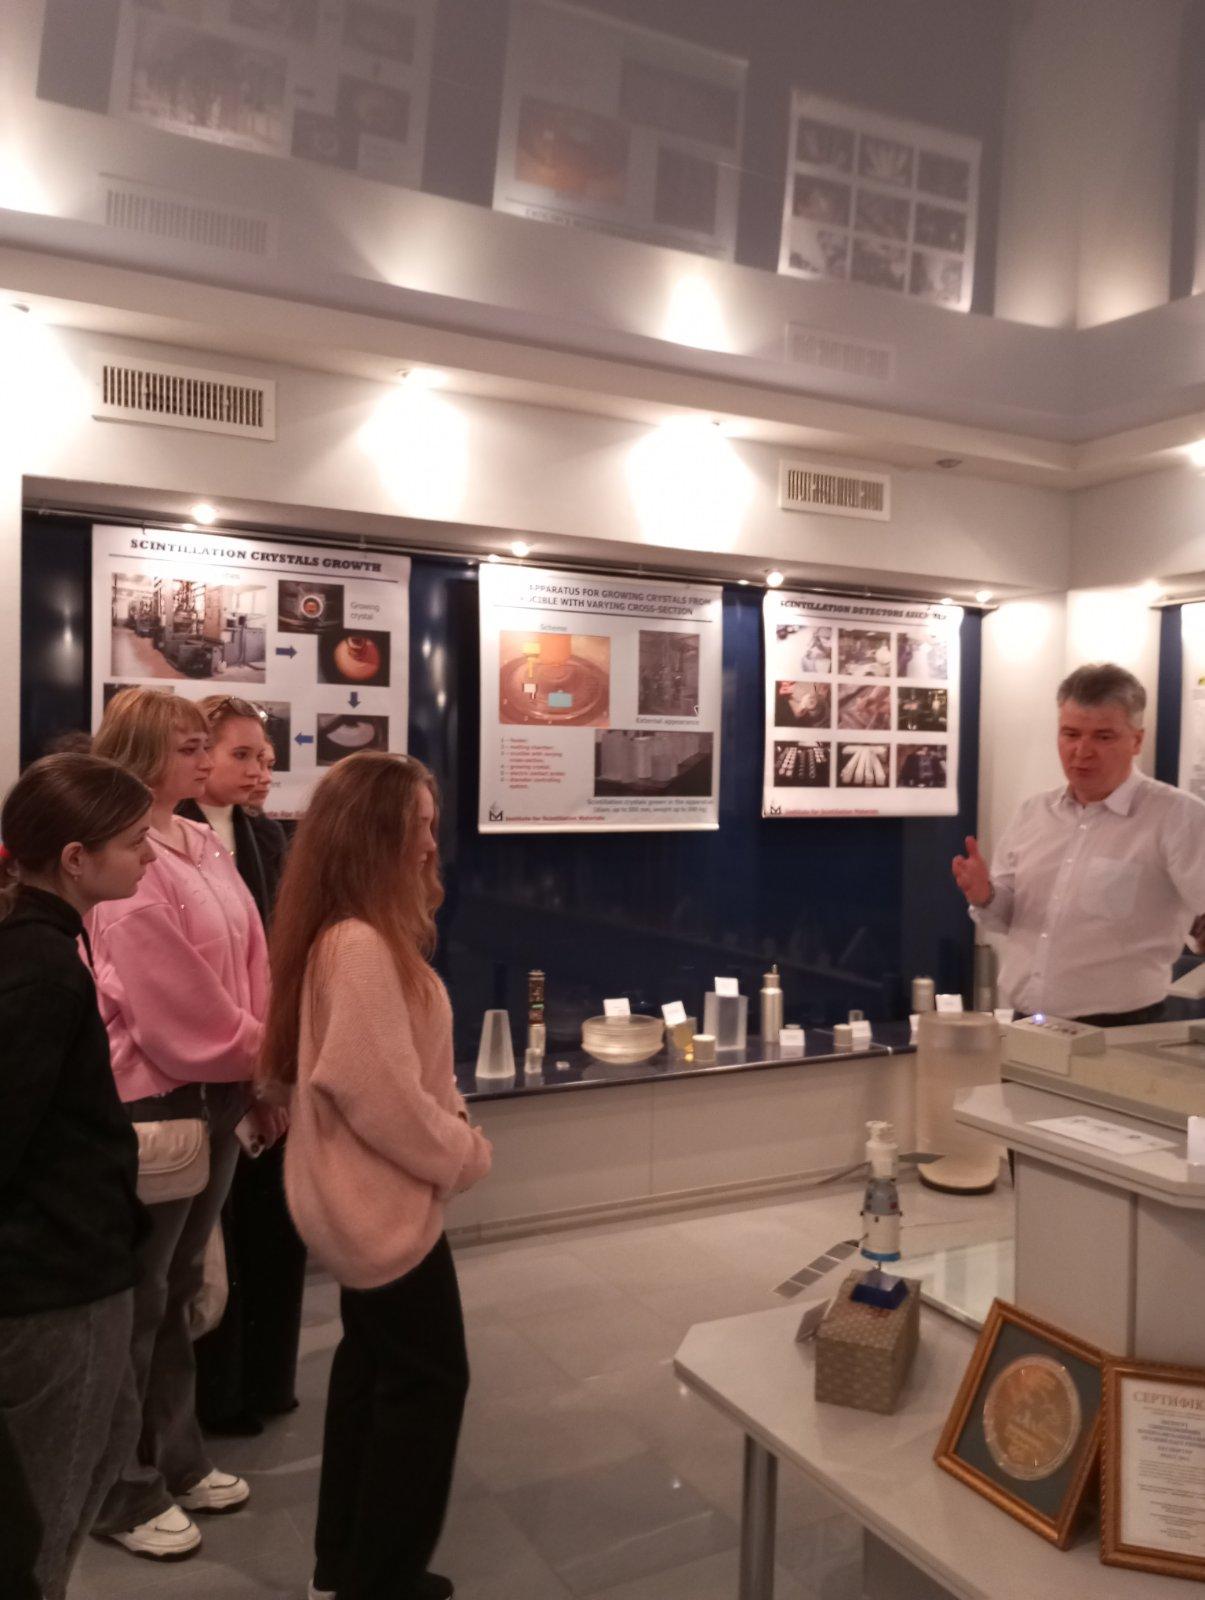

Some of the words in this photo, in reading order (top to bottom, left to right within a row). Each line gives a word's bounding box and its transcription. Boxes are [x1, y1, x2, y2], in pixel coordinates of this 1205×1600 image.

[130, 538, 247, 560] SCINTILLATION
[250, 551, 320, 567] CRYSTALS
[322, 558, 382, 573] GROWTH
[582, 588, 600, 597] FOR
[601, 589, 644, 601] GROWING
[645, 593, 687, 605] CRYSTALS
[560, 598, 585, 607] WITH
[586, 600, 626, 611] VARYING
[627, 603, 693, 616] CROSS-SECTION
[852, 607, 903, 618] DETECTORS
